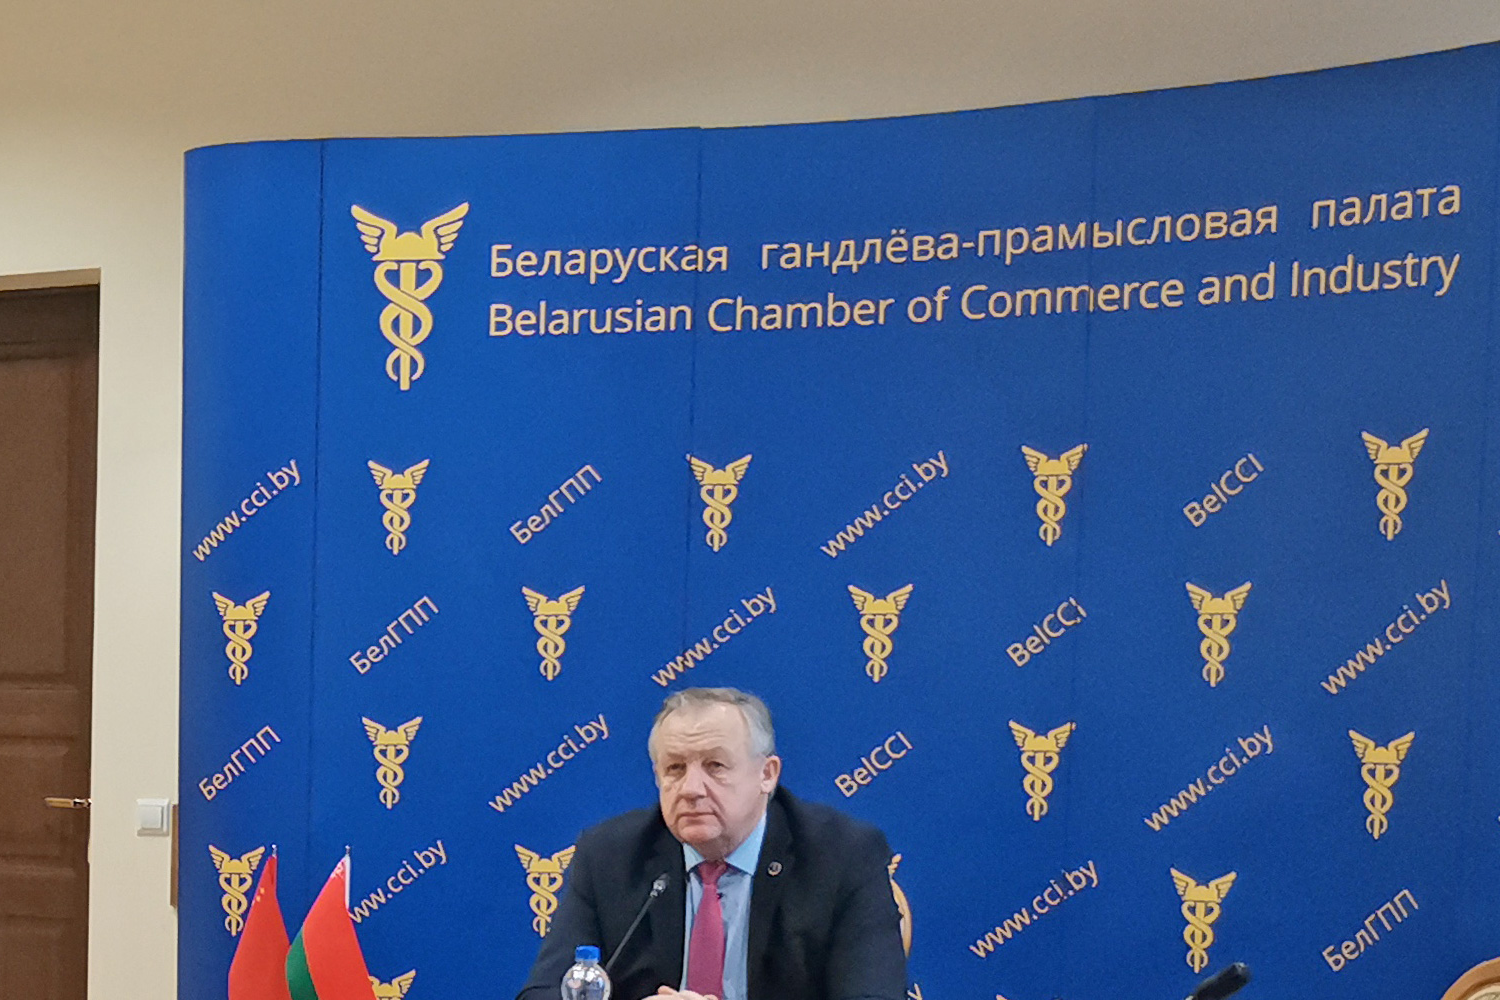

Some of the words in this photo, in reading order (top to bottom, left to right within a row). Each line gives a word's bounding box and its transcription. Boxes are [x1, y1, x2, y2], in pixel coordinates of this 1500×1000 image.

[490, 243, 728, 285] Беларуская
[761, 205, 1278, 274] гандлёва-прамысловая
[1312, 185, 1461, 229] палата
[489, 299, 692, 337] Belarusian
[708, 292, 895, 332] Chamber
[907, 285, 952, 323] of
[961, 279, 1185, 320] Commerce
[1198, 261, 1275, 305] and
[1291, 252, 1460, 297] Industry
[192, 460, 300, 562] www.cci.by
[509, 464, 602, 544] БелГПП
[820, 450, 949, 558] www.cci.by
[1183, 453, 1264, 527] BelCCI
[349, 595, 439, 675] БелГПП
[651, 587, 776, 687] www.cci.by
[1006, 597, 1087, 667] BelCCI
[1320, 579, 1450, 695] www.cci.by
[198, 725, 281, 801] БелГПП
[488, 714, 609, 813] www.cci.by
[834, 731, 913, 798] BelCCI
[1144, 725, 1273, 831] www.cci.by
[348, 839, 448, 923] ww.cci.by
[969, 860, 1098, 958] www.cci.by
[1322, 889, 1419, 971] БелГПП
